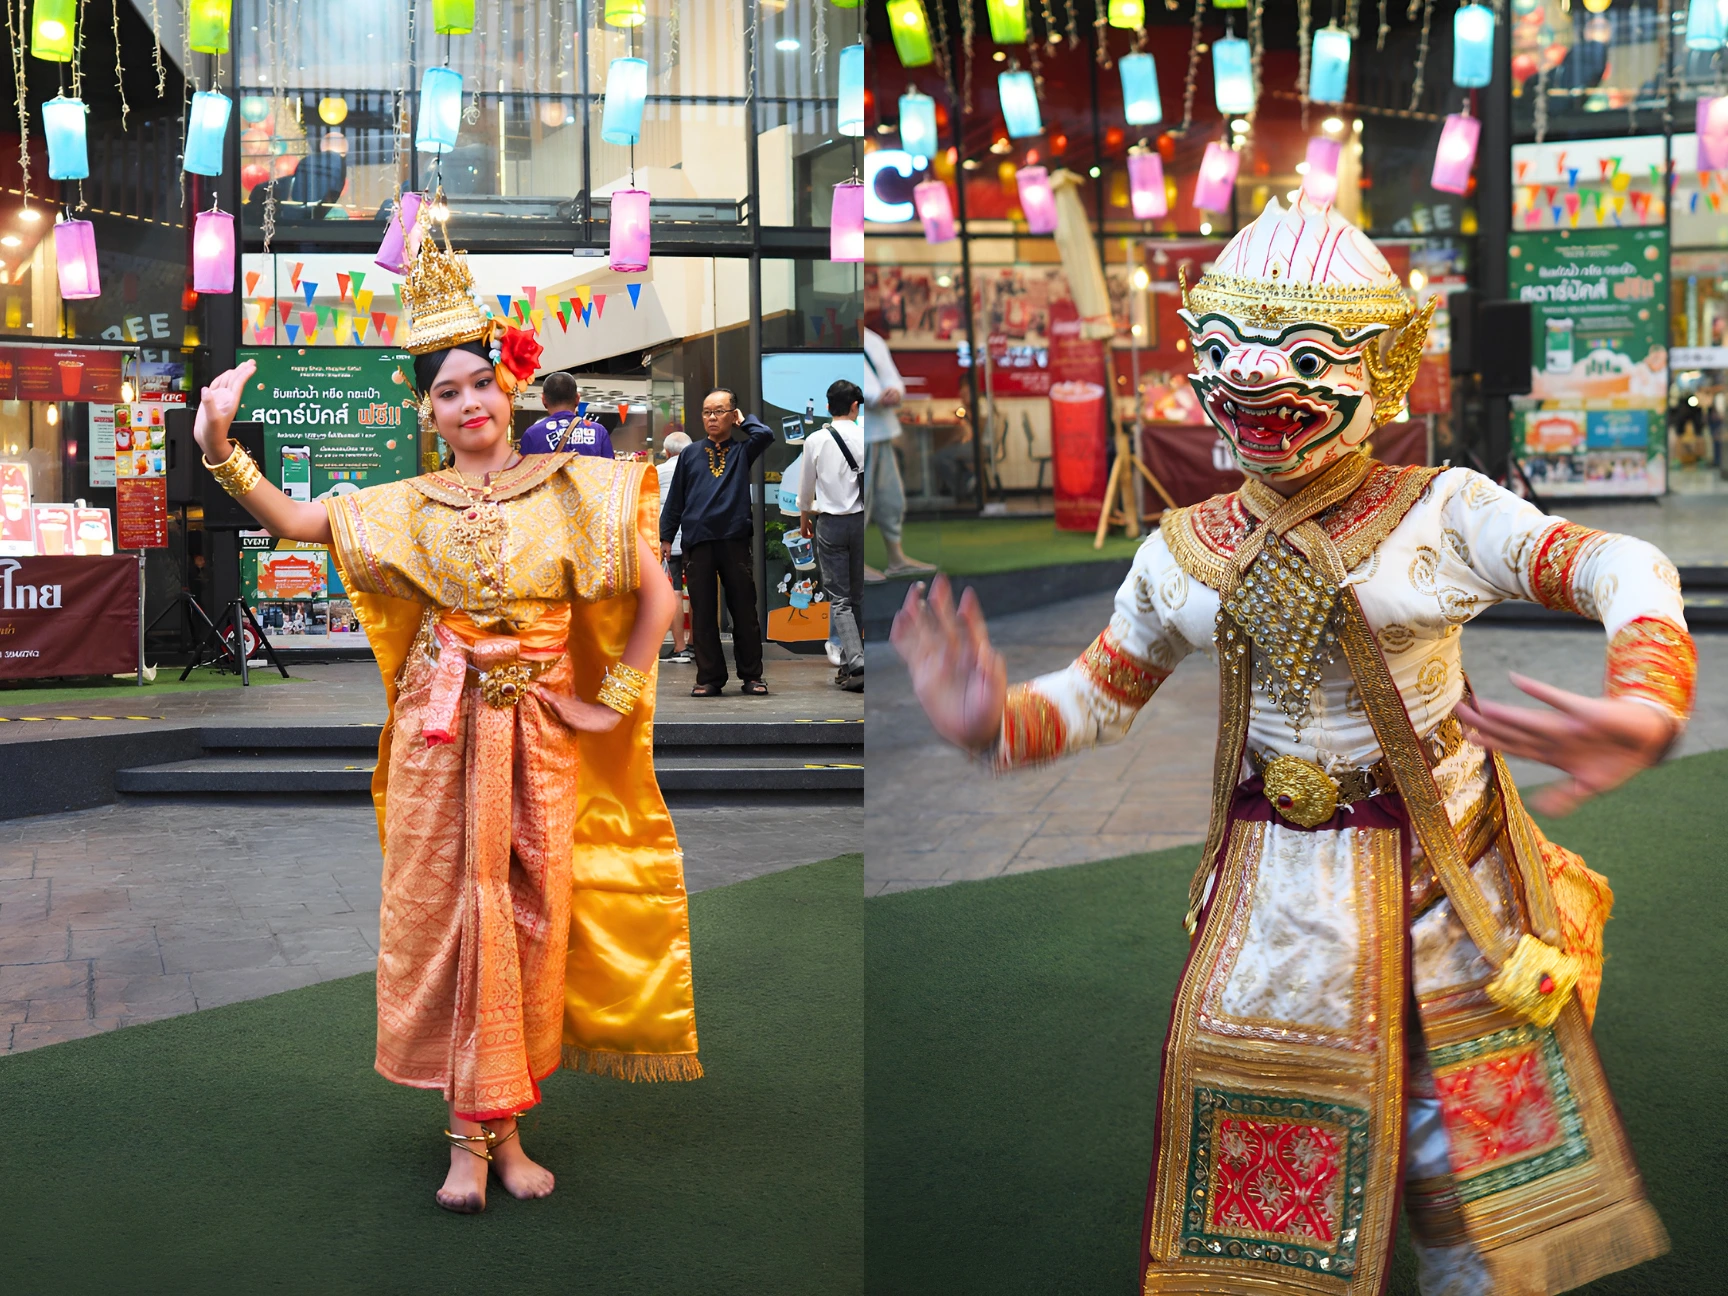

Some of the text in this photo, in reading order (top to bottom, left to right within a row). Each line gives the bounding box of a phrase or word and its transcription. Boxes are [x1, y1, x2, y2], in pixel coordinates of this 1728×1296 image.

[161, 393, 183, 402] KFC
[252, 402, 401, 425] สตาร์บัคส์ ฟรี!!
[243, 537, 271, 546] EVENT
[0, 558, 62, 609] ไทย
